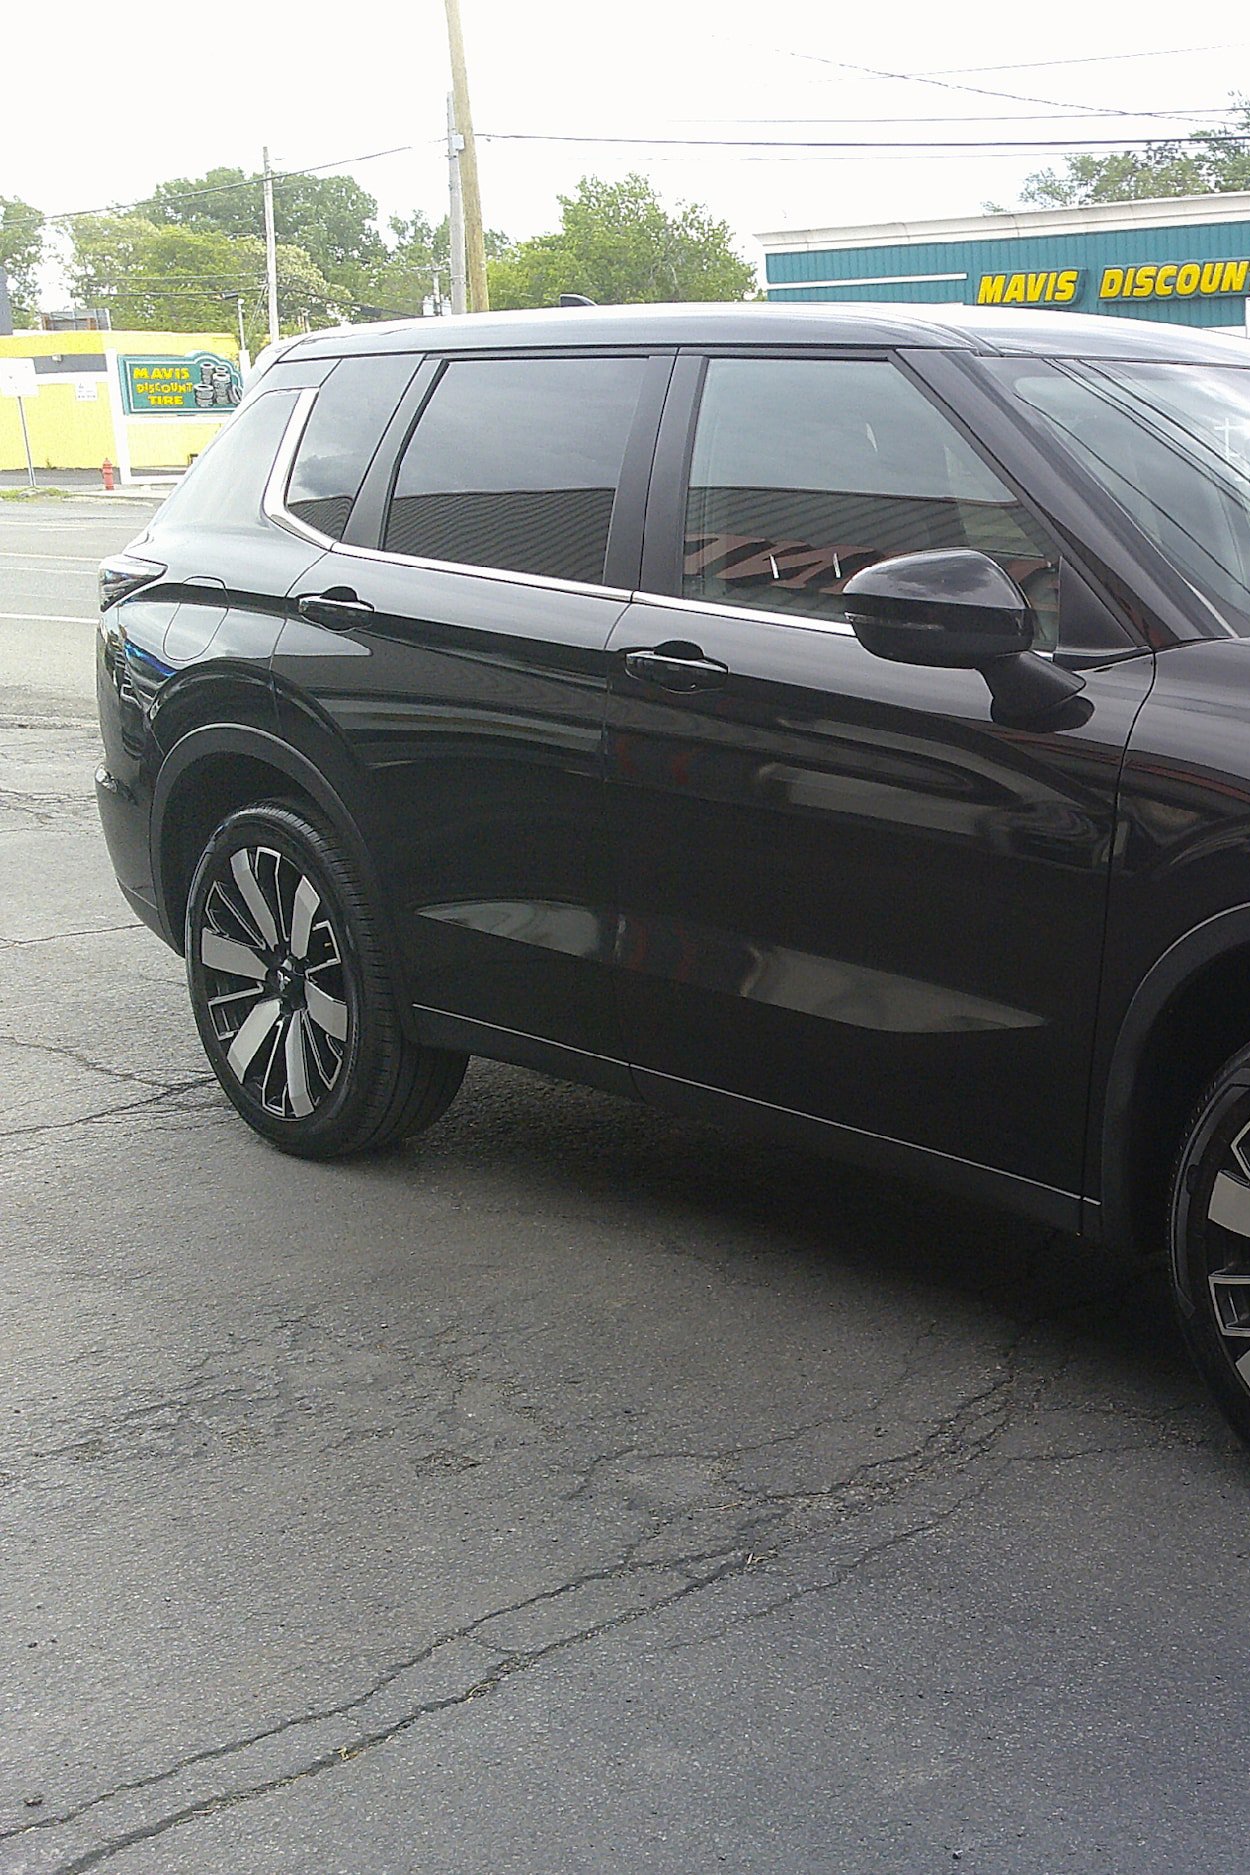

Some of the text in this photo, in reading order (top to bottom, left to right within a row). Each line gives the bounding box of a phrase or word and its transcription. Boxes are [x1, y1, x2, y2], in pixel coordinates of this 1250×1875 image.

[978, 271, 1079, 304] MAVIS
[133, 368, 190, 379] MAVIS
[136, 382, 193, 394] DISCOUNT
[148, 395, 184, 405] TIRE
